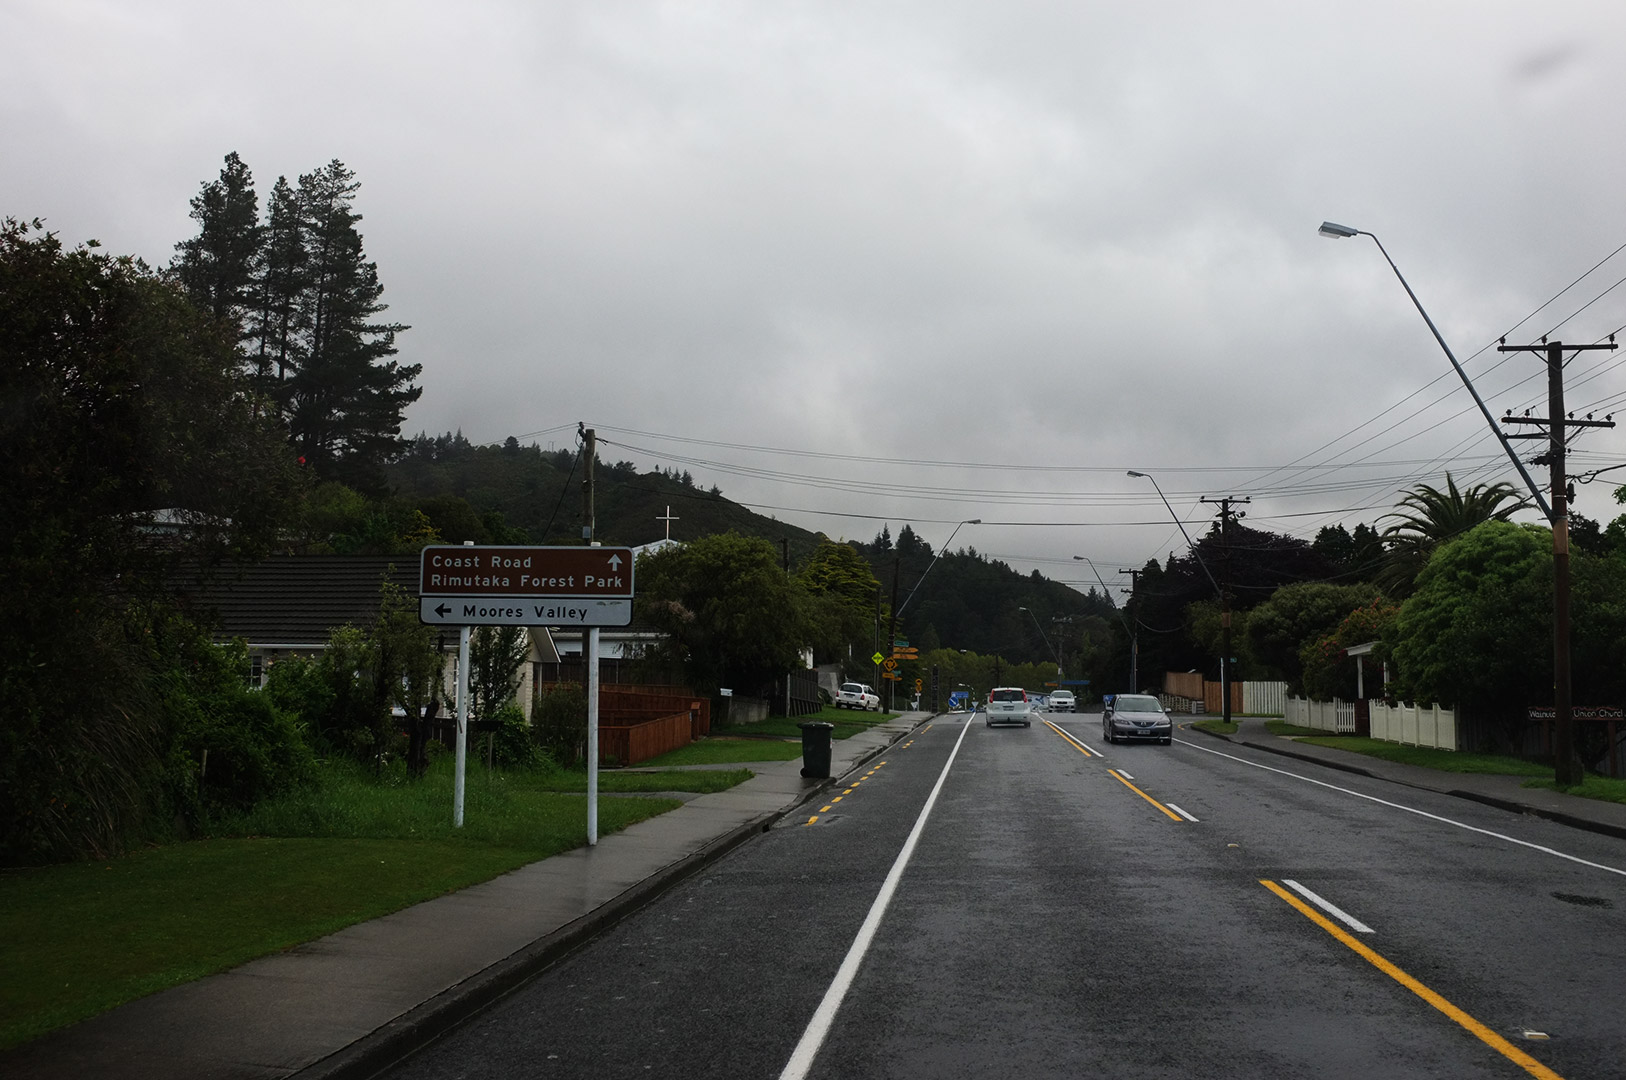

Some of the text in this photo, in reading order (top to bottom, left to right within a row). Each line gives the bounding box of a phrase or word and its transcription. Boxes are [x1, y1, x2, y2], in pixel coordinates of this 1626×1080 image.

[432, 555, 532, 568] Coast Road
[431, 574, 623, 588] Rimutaka Forest Park
[463, 605, 588, 621] Moores Valley
[1573, 709, 1597, 718] Union
